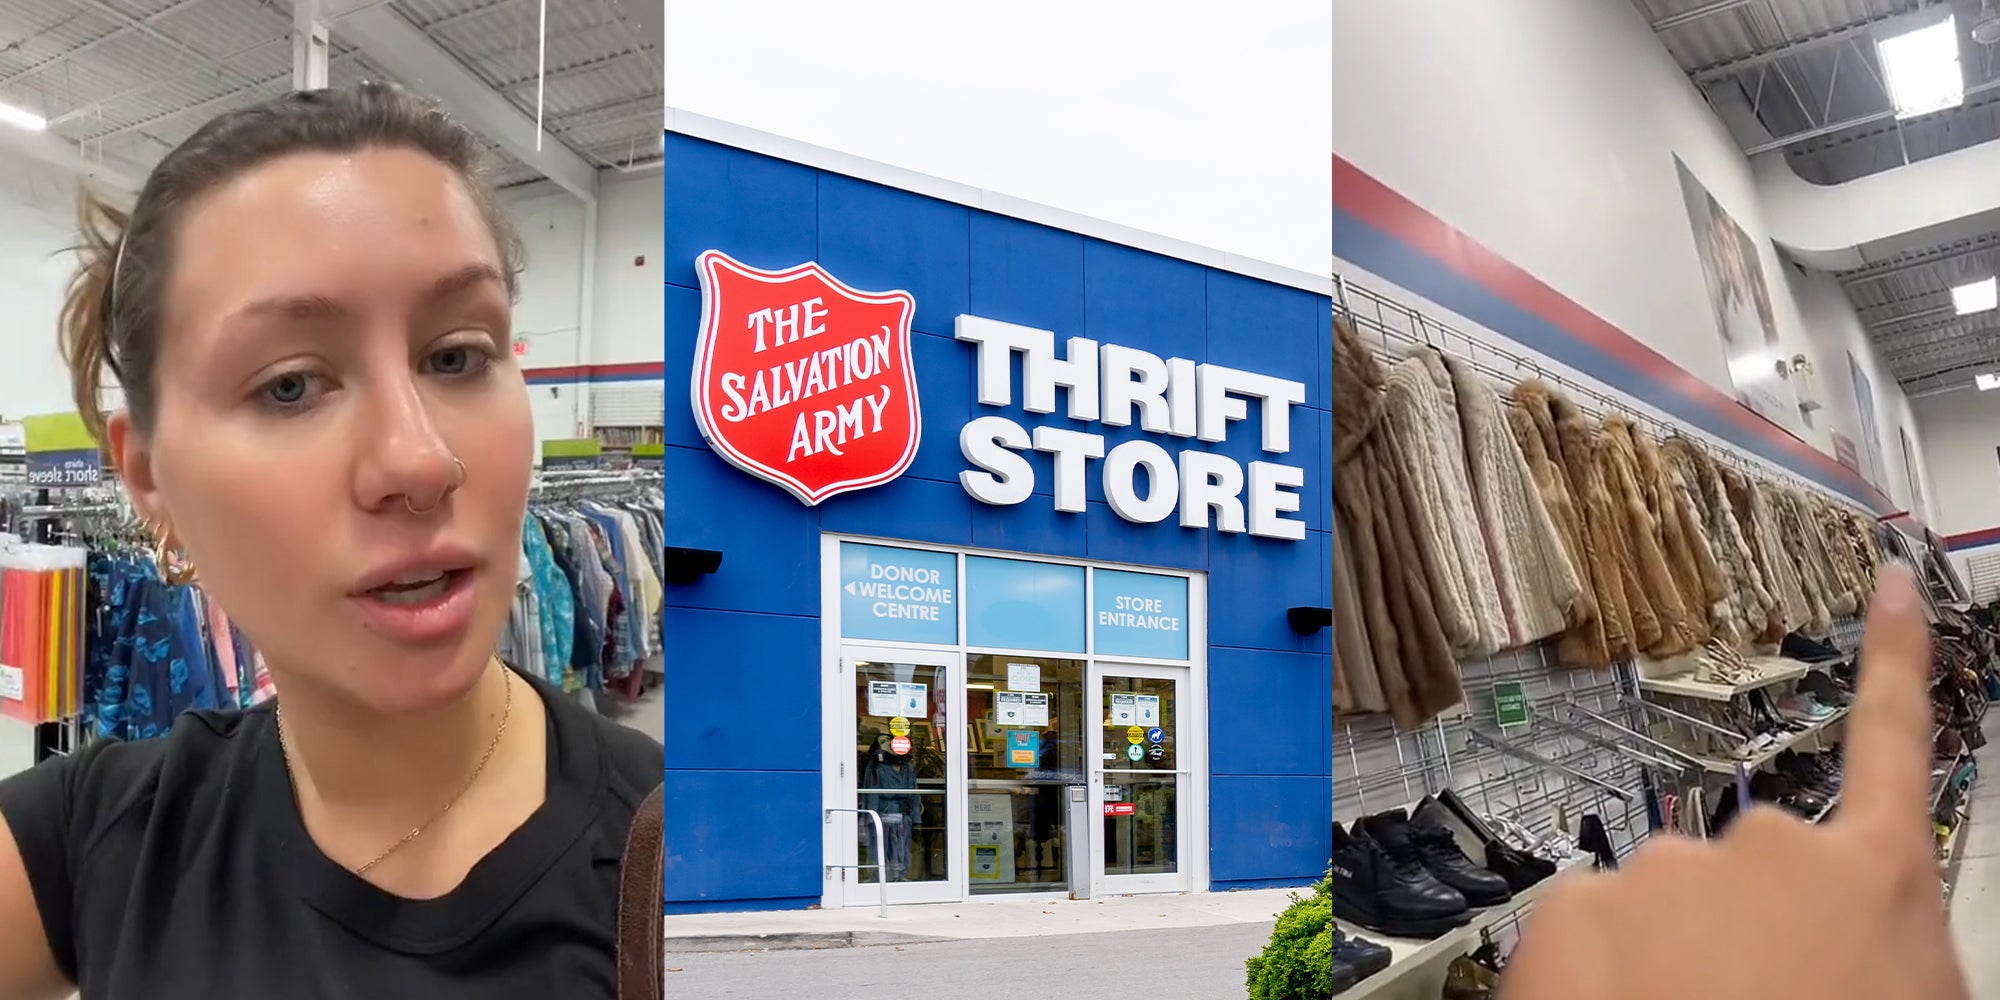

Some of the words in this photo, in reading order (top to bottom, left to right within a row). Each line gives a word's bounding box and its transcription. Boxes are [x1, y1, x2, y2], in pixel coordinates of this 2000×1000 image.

[747, 297, 828, 353] THE
[720, 325, 890, 422] SALVATION
[955, 314, 1305, 453] THRIFT
[786, 384, 890, 462] ARMY
[959, 416, 1305, 540] STORE
[859, 581, 952, 604] WELCOME
[871, 563, 940, 585] DONOR
[872, 601, 940, 621] CENTRE
[1099, 611, 1180, 631] ENTRANCE
[1115, 595, 1162, 613] STORE
